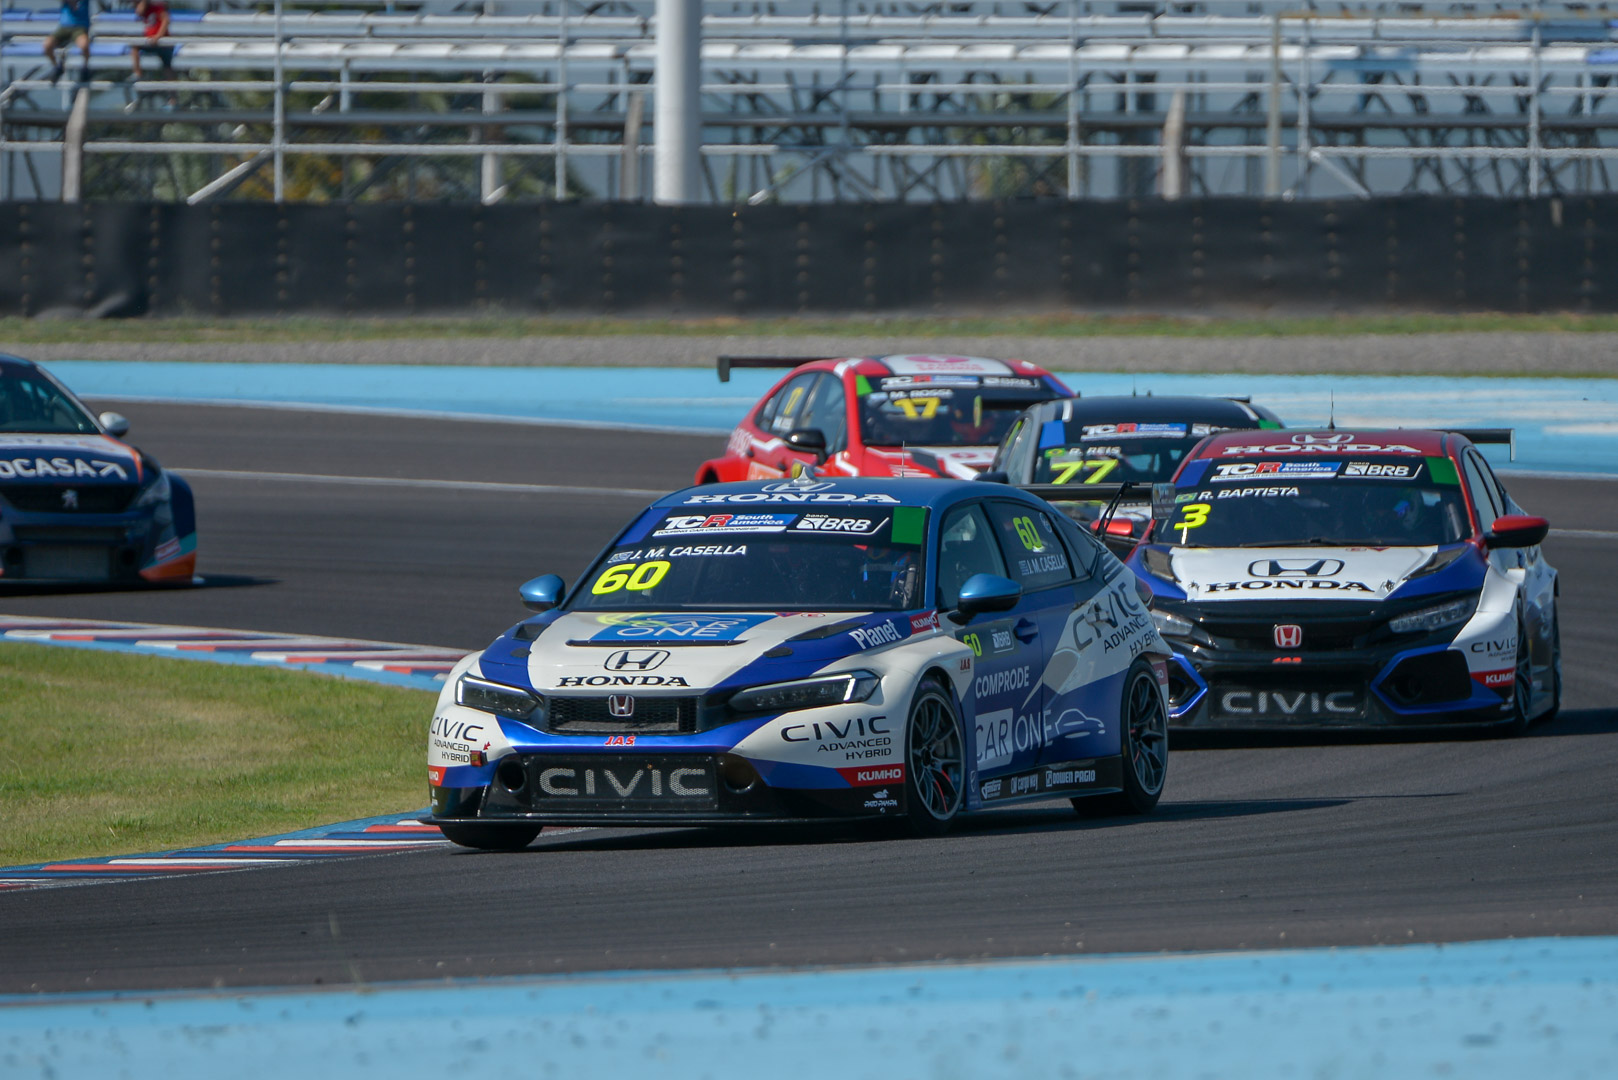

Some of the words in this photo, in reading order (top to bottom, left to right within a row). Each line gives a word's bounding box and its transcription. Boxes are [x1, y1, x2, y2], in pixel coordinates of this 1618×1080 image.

[894, 397, 941, 419] 17
[1081, 423, 1137, 435] TCR
[1087, 446, 1122, 456] REIS
[1223, 444, 1422, 455] HONDA
[1051, 459, 1119, 485] 77
[1216, 462, 1282, 475] TCR
[1366, 464, 1410, 477] BRB
[683, 493, 901, 504] HONDA
[1198, 490, 1215, 501] R.
[1217, 486, 1300, 500] BAPTISTA
[664, 513, 734, 530] TCR
[729, 518, 784, 526] America
[1174, 503, 1212, 530] 3
[820, 518, 872, 531] BRB
[1013, 516, 1043, 550] 60
[629, 549, 641, 561] J.
[644, 547, 665, 560] M.
[668, 545, 748, 557] CASELLA
[1040, 554, 1068, 572] CASELLA
[591, 560, 672, 595] 60
[1205, 580, 1376, 593] HONDA
[911, 616, 938, 629] KUMHO
[617, 627, 723, 637] ONE
[848, 619, 902, 650] Planet
[1471, 637, 1517, 653] CIVIC
[556, 676, 692, 687] HONDA
[975, 665, 1030, 699] COMPRODE
[1222, 691, 1357, 714] CIVIC
[430, 716, 484, 742] CIVIC
[780, 715, 891, 743] CIVIC
[1015, 709, 1054, 753] ONE
[434, 738, 470, 753] ADVANCED
[604, 736, 636, 746] JAS
[817, 736, 892, 753] ADVANCED
[976, 718, 1009, 763] CAR
[441, 751, 470, 763] HYBRID
[846, 747, 892, 761] HYBRID
[539, 767, 709, 797] CIVIC
[857, 768, 902, 782] KUMHO
